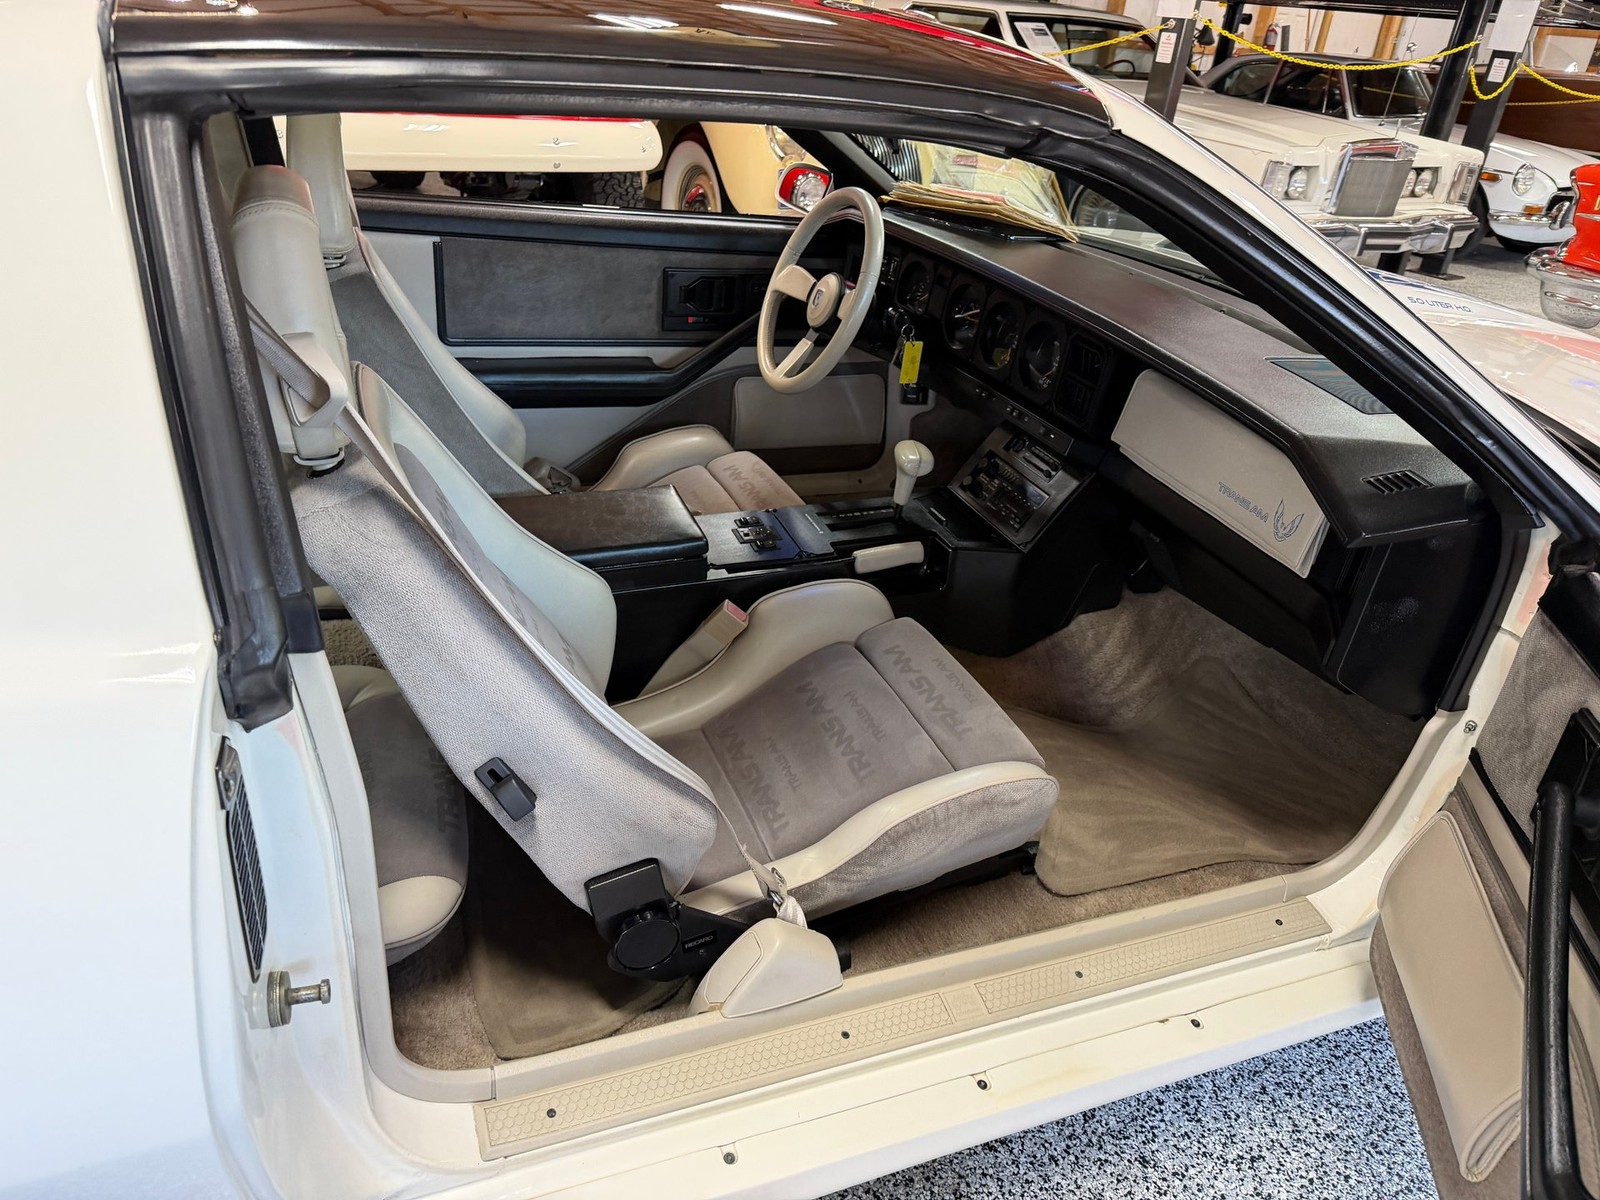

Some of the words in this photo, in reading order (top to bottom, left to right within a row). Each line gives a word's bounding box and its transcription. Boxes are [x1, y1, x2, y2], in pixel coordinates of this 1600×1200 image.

[1425, 299, 1454, 309] LITER
[1218, 481, 1251, 510] TRANS
[1249, 505, 1269, 523] AM
[882, 644, 922, 673] AM
[796, 680, 834, 715] AM
[908, 675, 973, 739] TRANS
[714, 723, 753, 762] AM
[820, 716, 876, 786] TRANS
[739, 761, 789, 840] TRANS
[685, 935, 713, 949] RECARO
